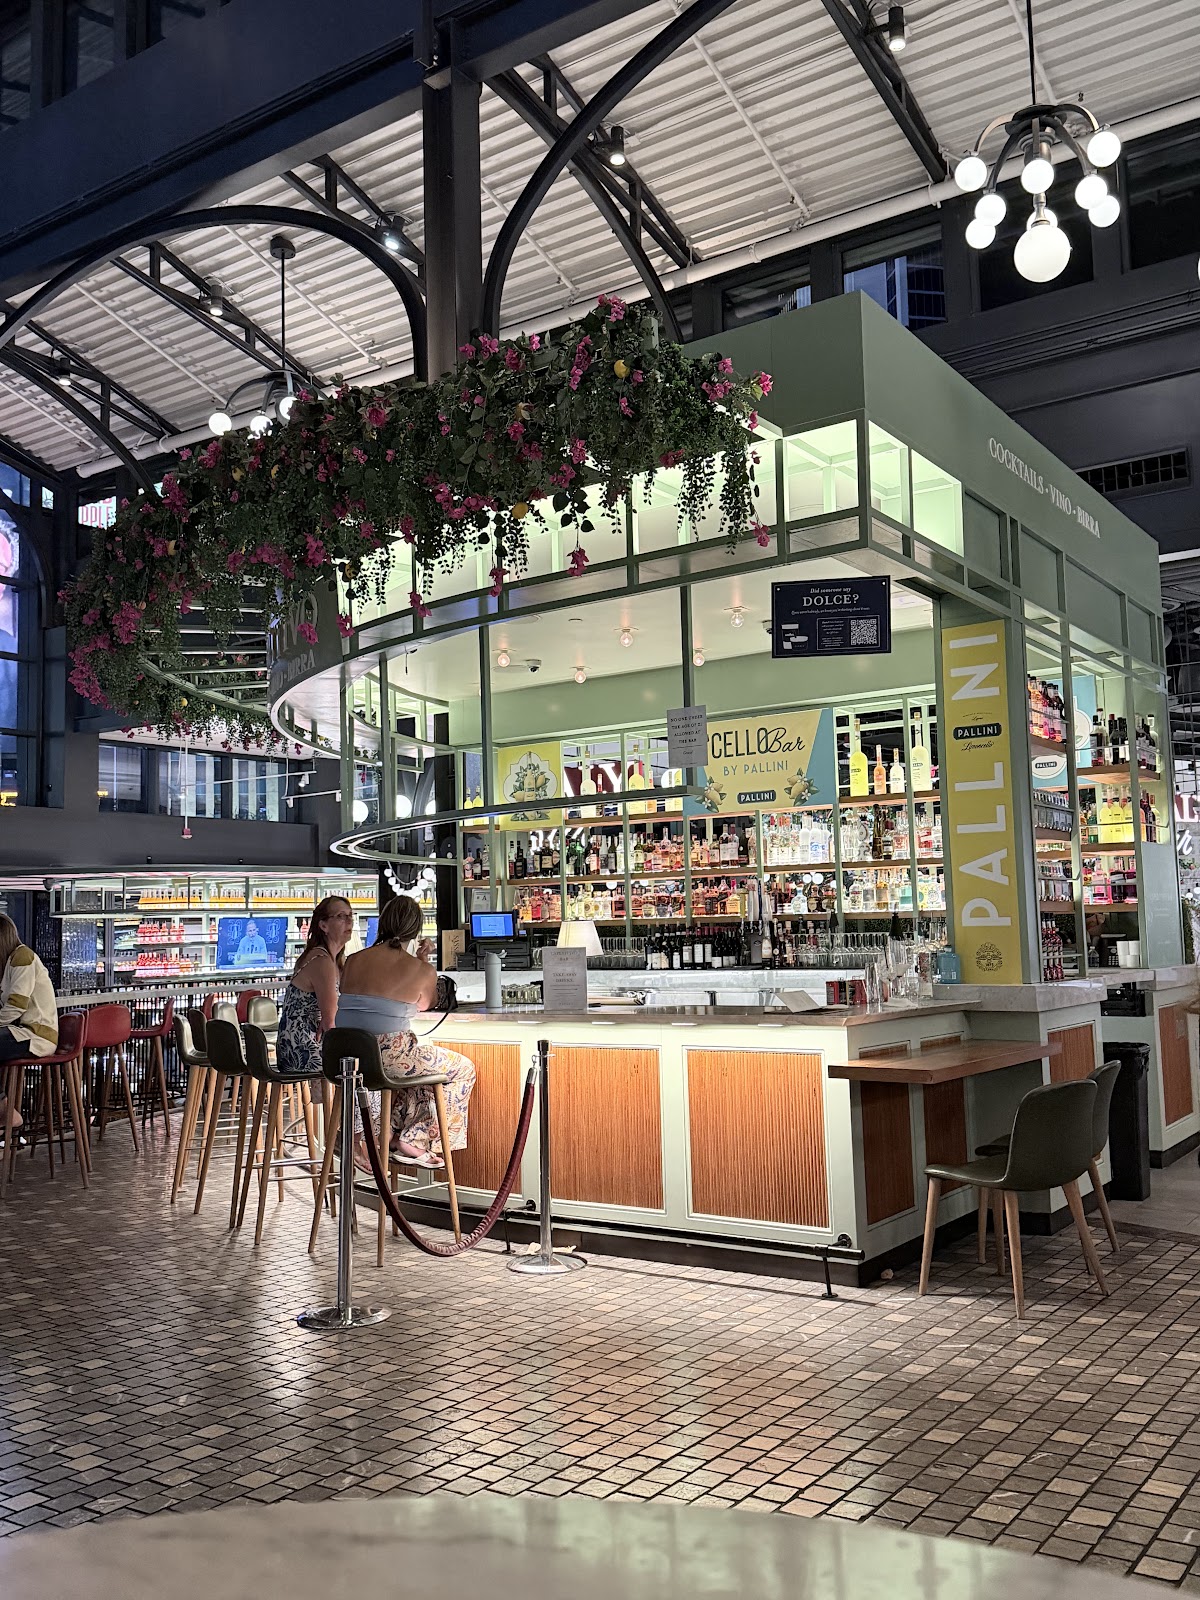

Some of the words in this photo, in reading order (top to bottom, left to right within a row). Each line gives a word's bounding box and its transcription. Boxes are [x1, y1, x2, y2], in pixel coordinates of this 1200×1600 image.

[989, 438, 1044, 494] COCKTAILS
[1049, 484, 1072, 515] VINO
[1077, 505, 1100, 538] BIRRA
[802, 593, 859, 607] DOLCE?
[957, 725, 998, 738] PALLINI
[706, 727, 769, 759] CELLO
[760, 727, 806, 754] Bar
[723, 765, 738, 776] BY
[743, 760, 789, 775] PALLINI
[1035, 761, 1056, 769] PALLINI
[949, 633, 1011, 927] PALLINI
[740, 792, 774, 802] PALLINI
